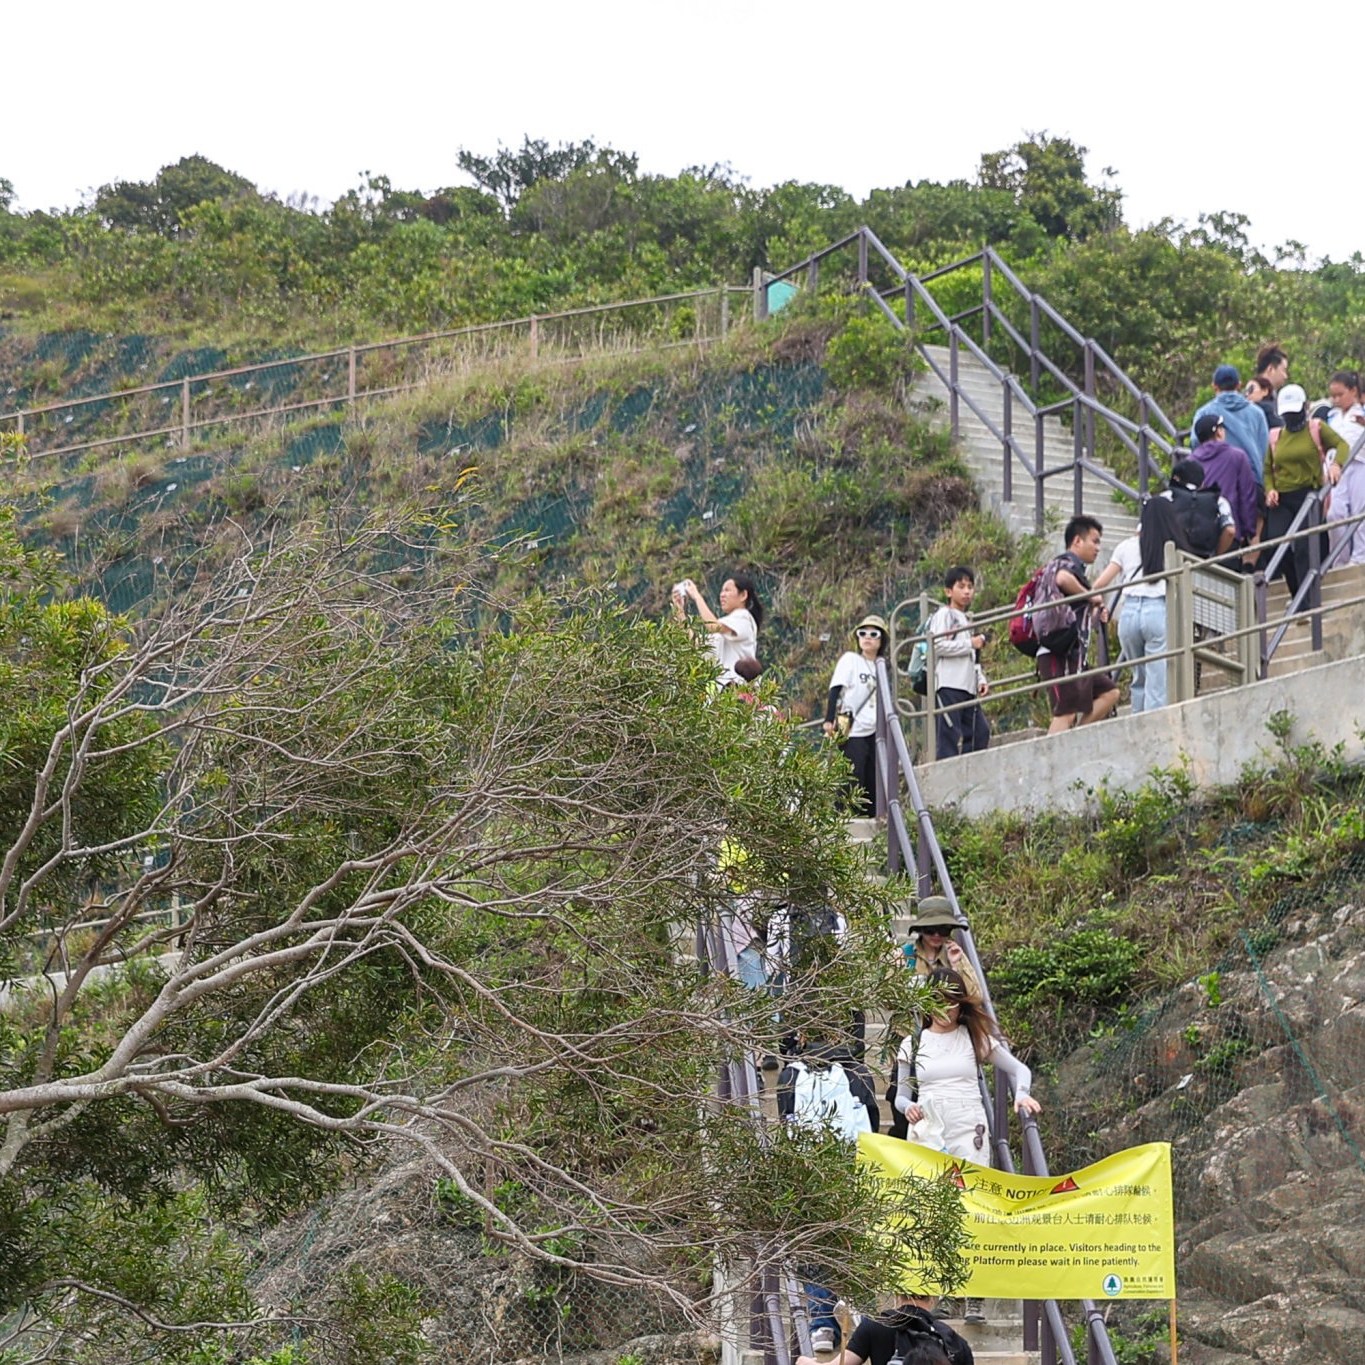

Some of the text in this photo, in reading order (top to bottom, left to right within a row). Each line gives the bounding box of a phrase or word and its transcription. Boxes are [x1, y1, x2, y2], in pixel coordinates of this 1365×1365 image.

[973, 1176, 1003, 1196] 注意
[1005, 1188, 1047, 1200] NOTI
[983, 1241, 1026, 1253] currently
[1029, 1242, 1038, 1252] in
[1040, 1242, 1067, 1253] place.
[1069, 1243, 1103, 1252] Visitors
[1104, 1243, 1137, 1253] heading
[1138, 1244, 1146, 1252] to
[1148, 1243, 1162, 1252] the
[973, 1256, 1016, 1266] Platform
[1017, 1257, 1048, 1267] please
[1050, 1257, 1070, 1266] wait
[1072, 1257, 1081, 1266] in
[1083, 1257, 1100, 1266] line
[1102, 1257, 1140, 1267] patiently.
